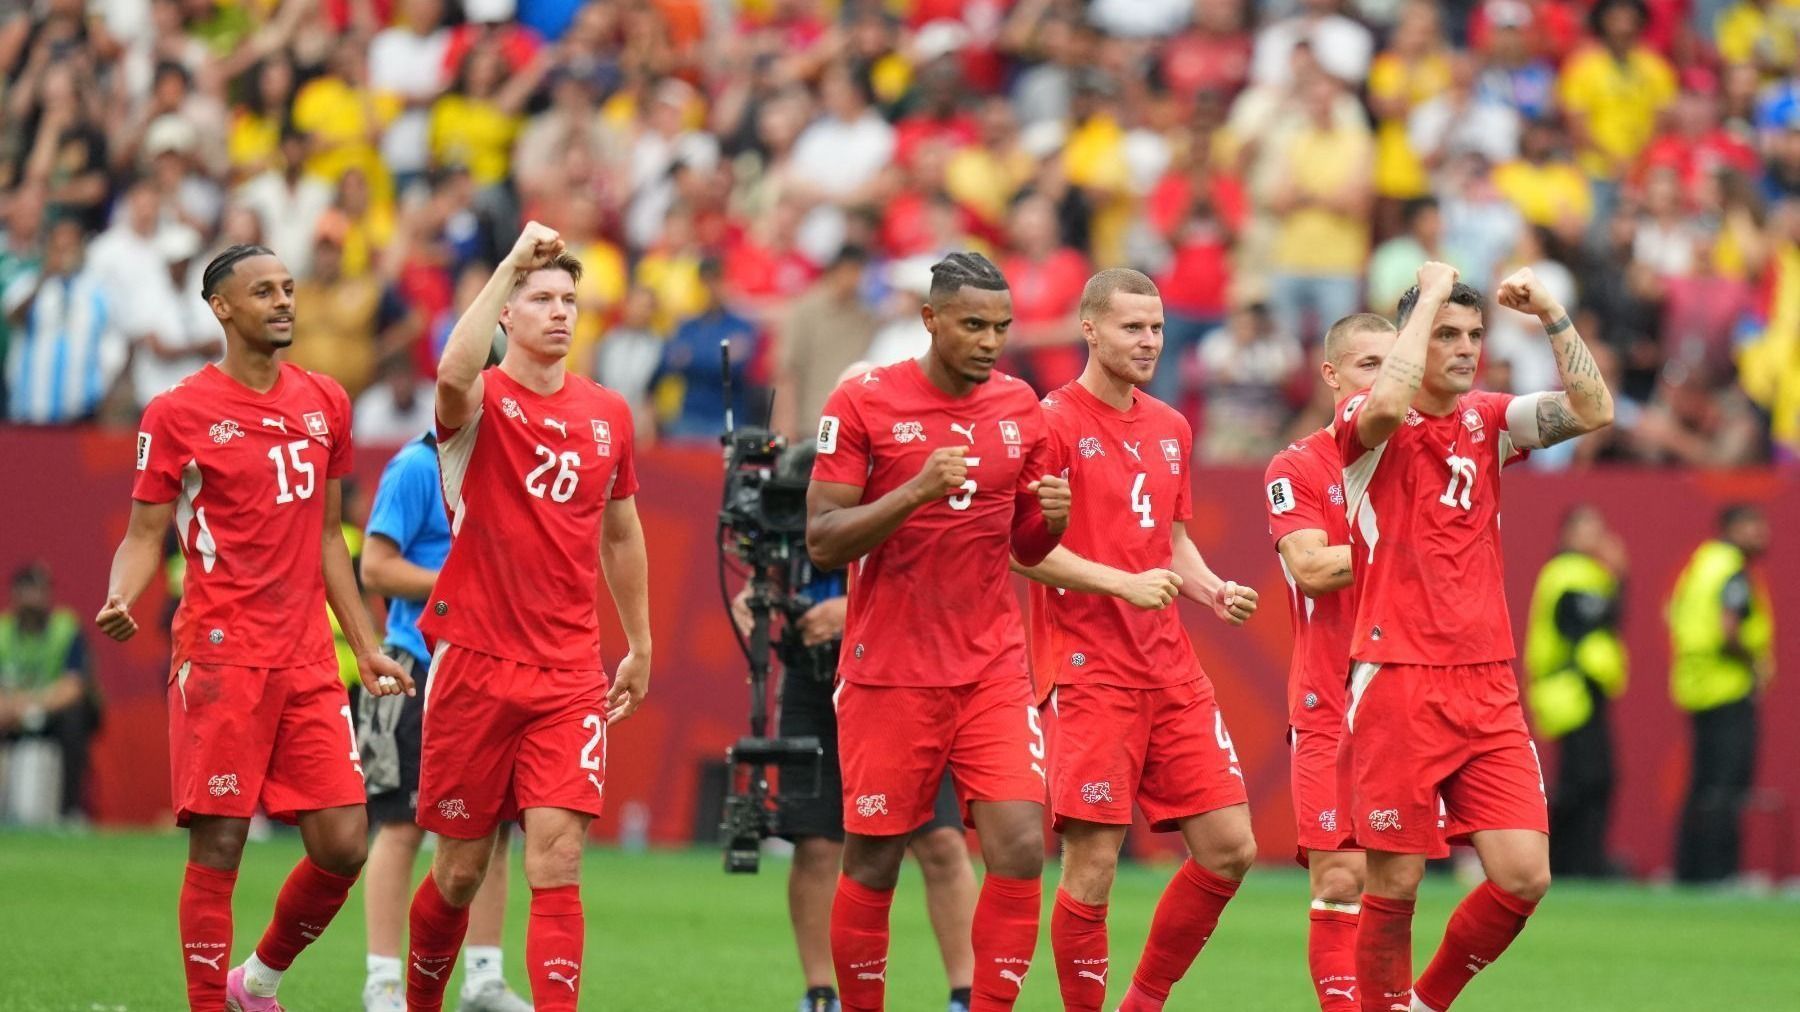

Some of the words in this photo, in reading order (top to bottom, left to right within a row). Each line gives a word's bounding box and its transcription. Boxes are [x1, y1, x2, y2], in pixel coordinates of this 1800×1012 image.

[268, 439, 314, 504] 15
[525, 444, 582, 503] 26
[948, 457, 981, 511] 5
[1130, 473, 1156, 528] 4
[339, 705, 361, 761] 1
[580, 714, 607, 773] 2
[1027, 706, 1046, 761] 5
[1214, 710, 1240, 763] 4
[994, 957, 1031, 966] suiss
